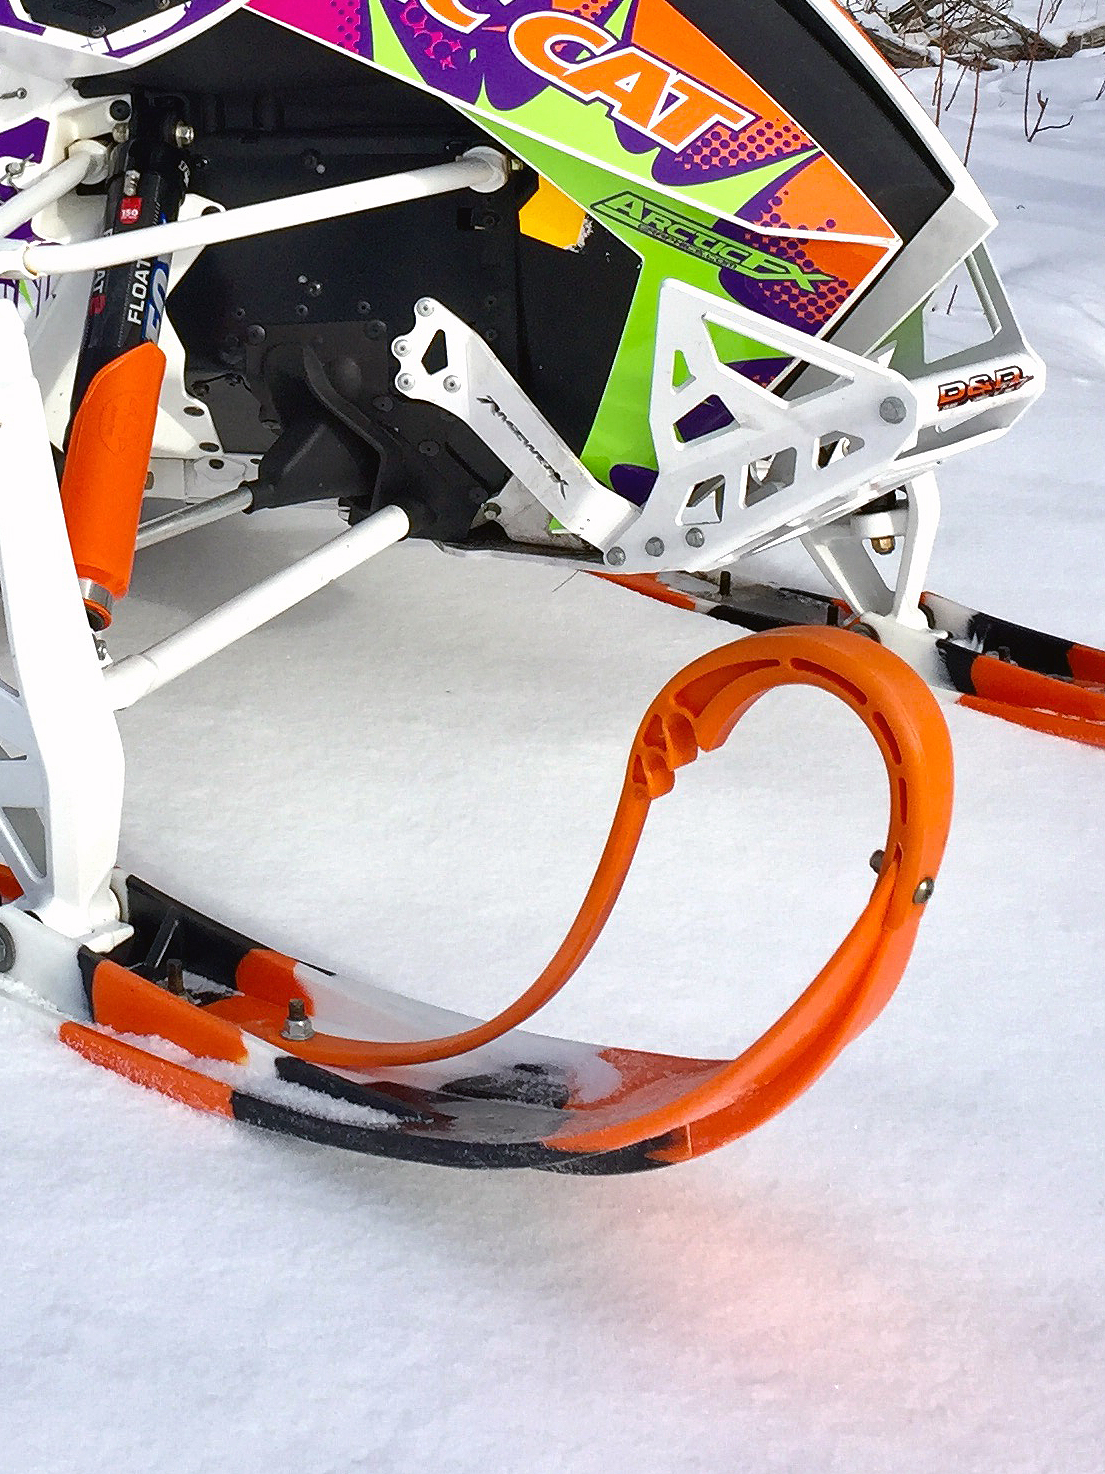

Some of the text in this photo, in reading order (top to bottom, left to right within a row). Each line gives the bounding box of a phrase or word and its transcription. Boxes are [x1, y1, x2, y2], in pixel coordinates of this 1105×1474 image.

[508, 10, 761, 154] CAT
[127, 258, 152, 325] FLOAT
[590, 190, 838, 294] ARCTICFX
